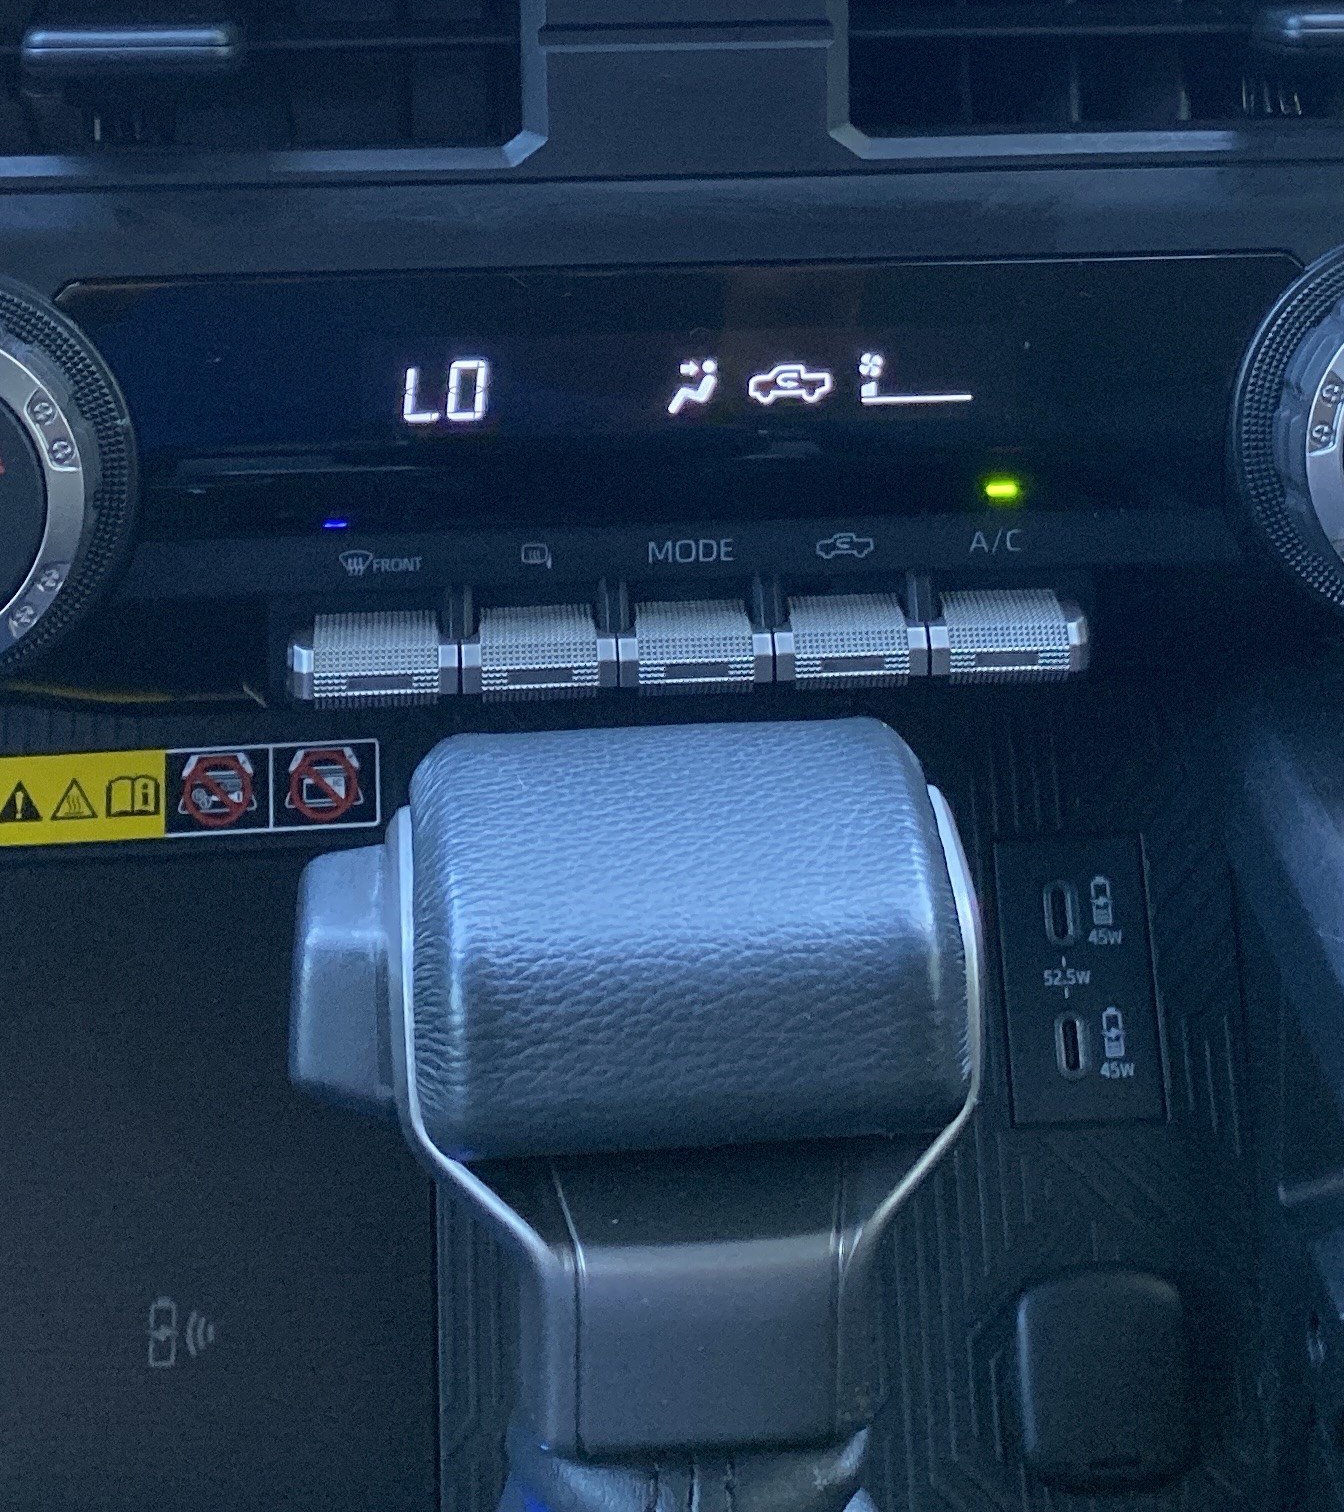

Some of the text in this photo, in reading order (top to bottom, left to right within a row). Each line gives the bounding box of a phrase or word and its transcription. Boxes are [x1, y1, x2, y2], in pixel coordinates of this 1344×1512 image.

[403, 360, 487, 424] LO
[968, 528, 1023, 554] A/C
[648, 538, 736, 563] MODE
[372, 556, 423, 572] FRONT
[1088, 928, 1123, 945] 45W
[1043, 968, 1092, 986] 52.5W
[1100, 1061, 1135, 1078] 45W
